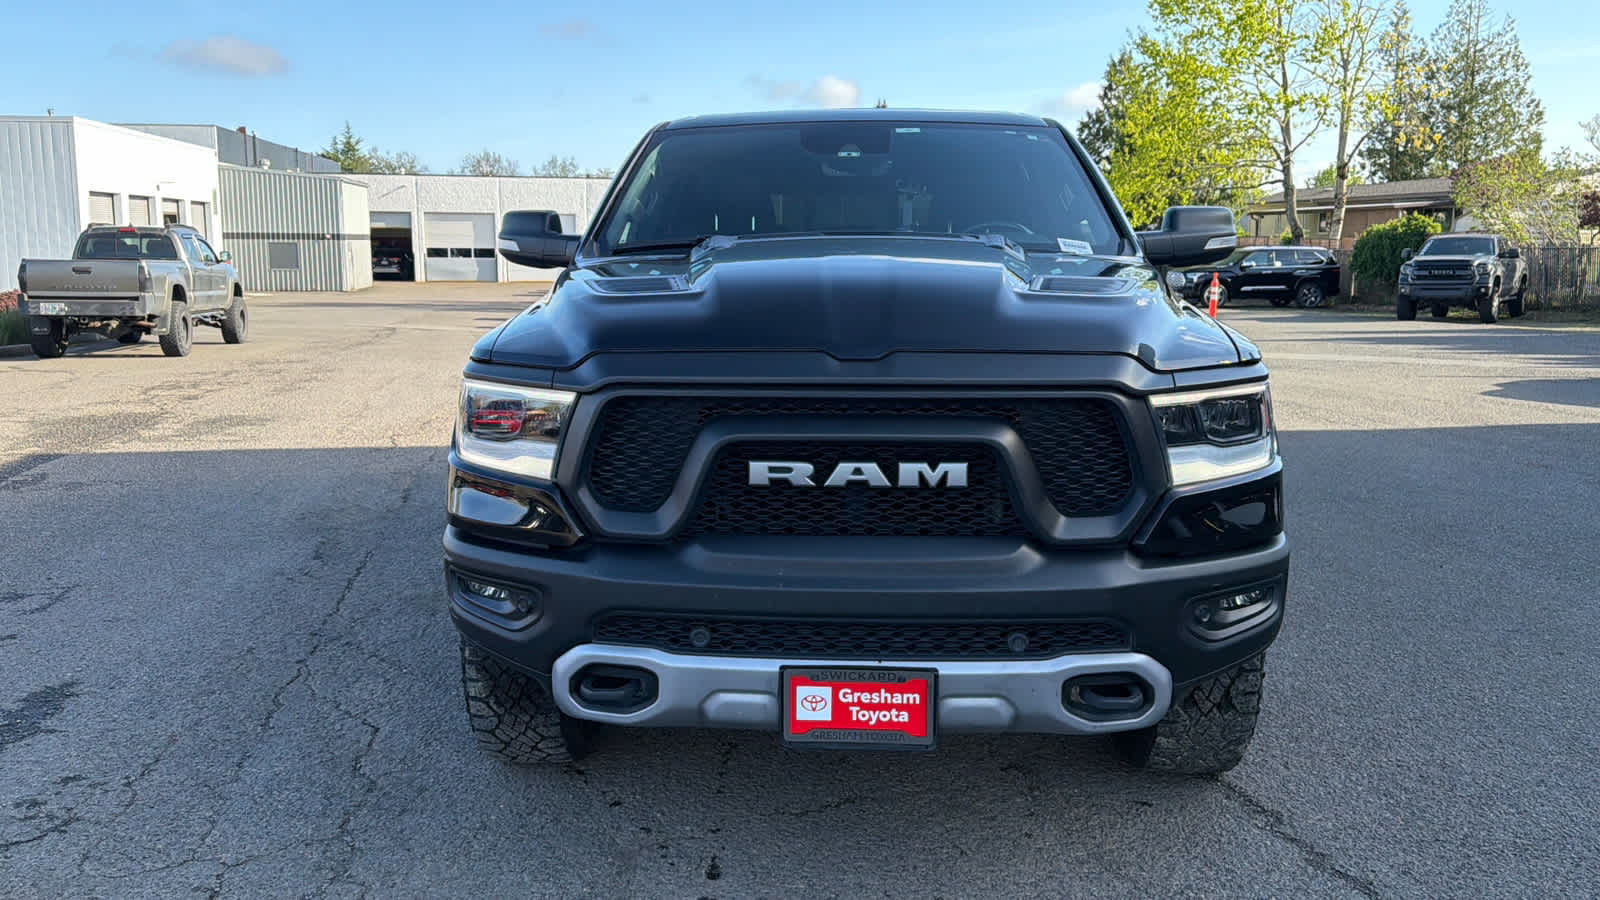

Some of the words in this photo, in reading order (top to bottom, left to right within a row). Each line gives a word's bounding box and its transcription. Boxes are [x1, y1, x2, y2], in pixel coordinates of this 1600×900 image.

[748, 460, 968, 487] RAM
[820, 671, 897, 681] SWICKARD
[838, 688, 920, 704] Gresham
[849, 706, 909, 725] Toyota
